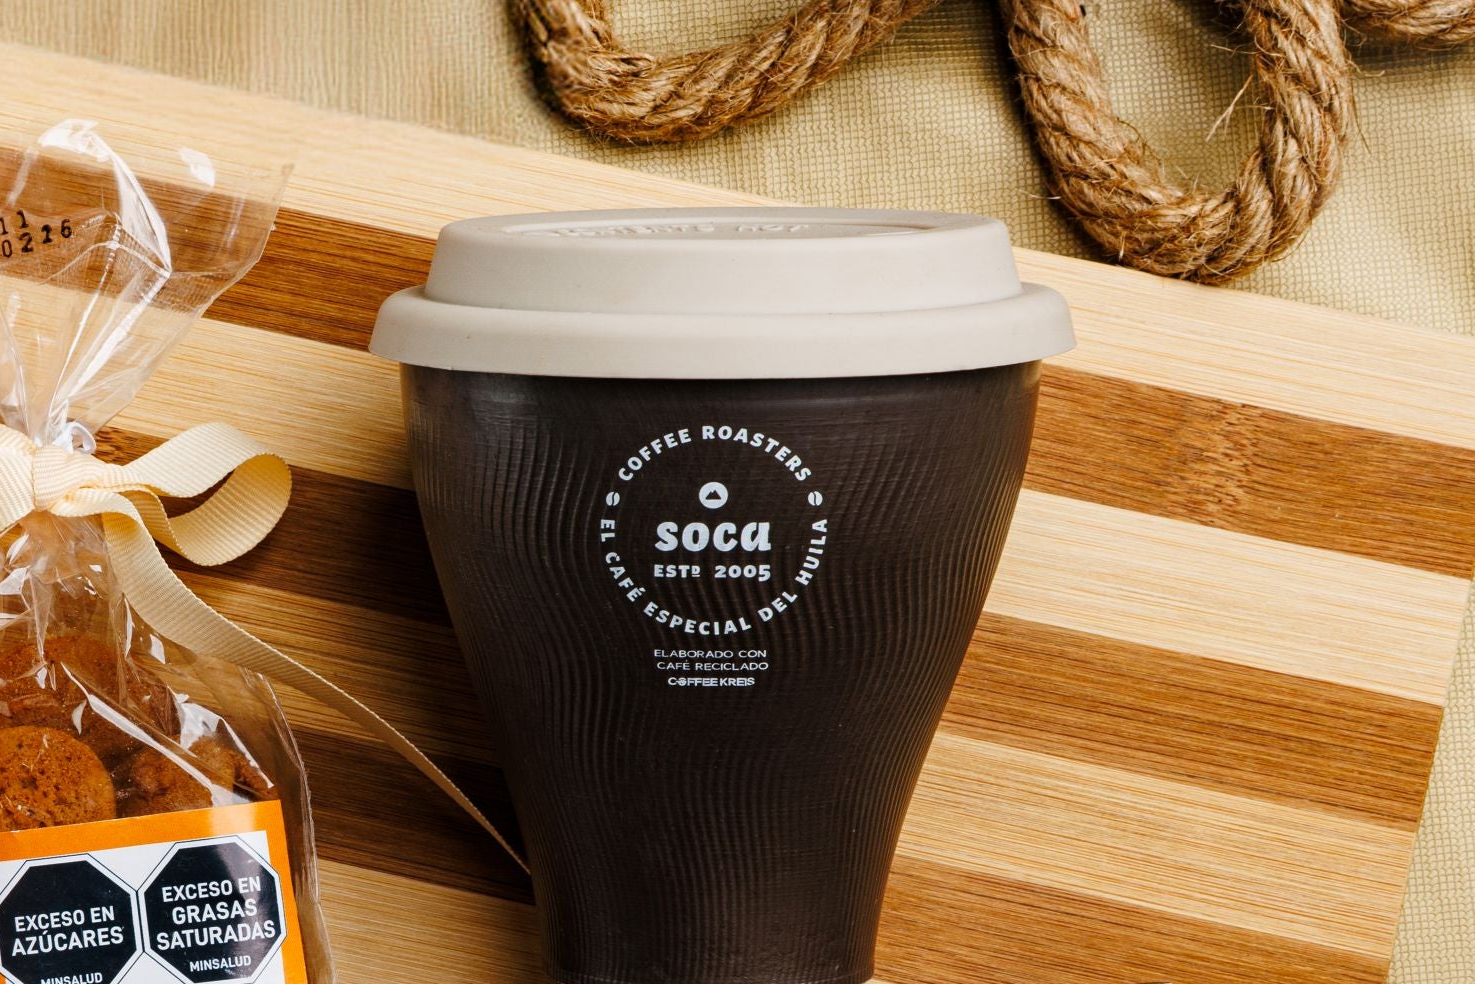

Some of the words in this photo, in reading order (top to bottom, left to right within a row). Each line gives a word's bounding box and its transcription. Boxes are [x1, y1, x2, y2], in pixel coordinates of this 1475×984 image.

[618, 428, 692, 481] COFFEE
[702, 425, 812, 482] ROASTERS
[600, 519, 616, 543] EL
[654, 521, 772, 552] soca
[794, 518, 828, 586] HUILA
[605, 551, 646, 603] CAFÉ
[714, 564, 771, 582] 2005
[642, 601, 752, 636] ESPECIAL
[757, 591, 798, 622] DEL
[654, 649, 734, 658] ELABORADO
[738, 649, 767, 659] CON
[657, 659, 691, 671] CAFÉ
[695, 661, 769, 671] RECICLADO
[161, 879, 233, 903] EXCESO
[238, 876, 262, 893] EN
[14, 909, 85, 932] EXCESO
[90, 905, 115, 923] EN
[171, 898, 258, 925] GRASAS
[11, 926, 124, 957] AZÚCARES
[156, 919, 276, 951] SATURADAS
[189, 954, 252, 973] MINSALUD
